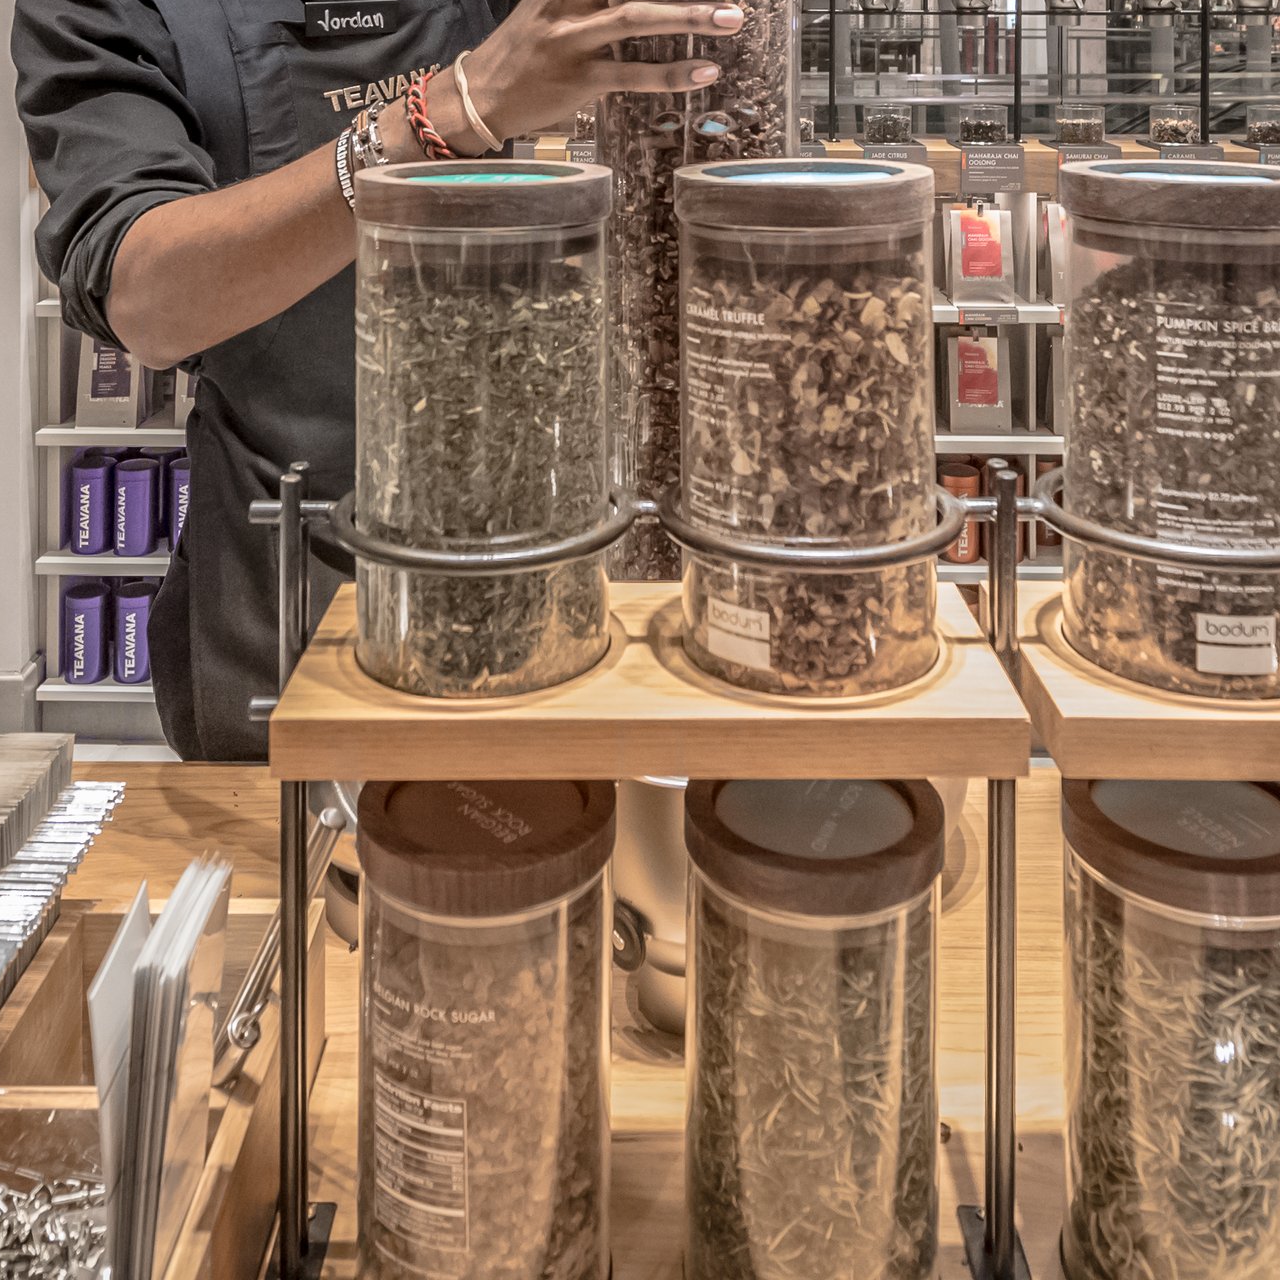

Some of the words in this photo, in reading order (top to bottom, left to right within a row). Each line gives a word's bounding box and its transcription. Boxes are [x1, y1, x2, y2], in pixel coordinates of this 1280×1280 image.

[317, 9, 384, 32] Jordan
[723, 312, 765, 325] TRUFFLE
[1157, 315, 1218, 332] PUMPKIN
[1223, 320, 1259, 334] SPICE
[79, 484, 90, 548] TEAVANA
[117, 486, 126, 549] TEAVANA
[713, 603, 763, 632] bodum
[1205, 621, 1269, 637] bodum
[74, 614, 85, 679] TEAVANA
[125, 612, 136, 678] TEAVANA
[414, 1003, 446, 1021] ROCK
[452, 1010, 496, 1024] SUGAR
